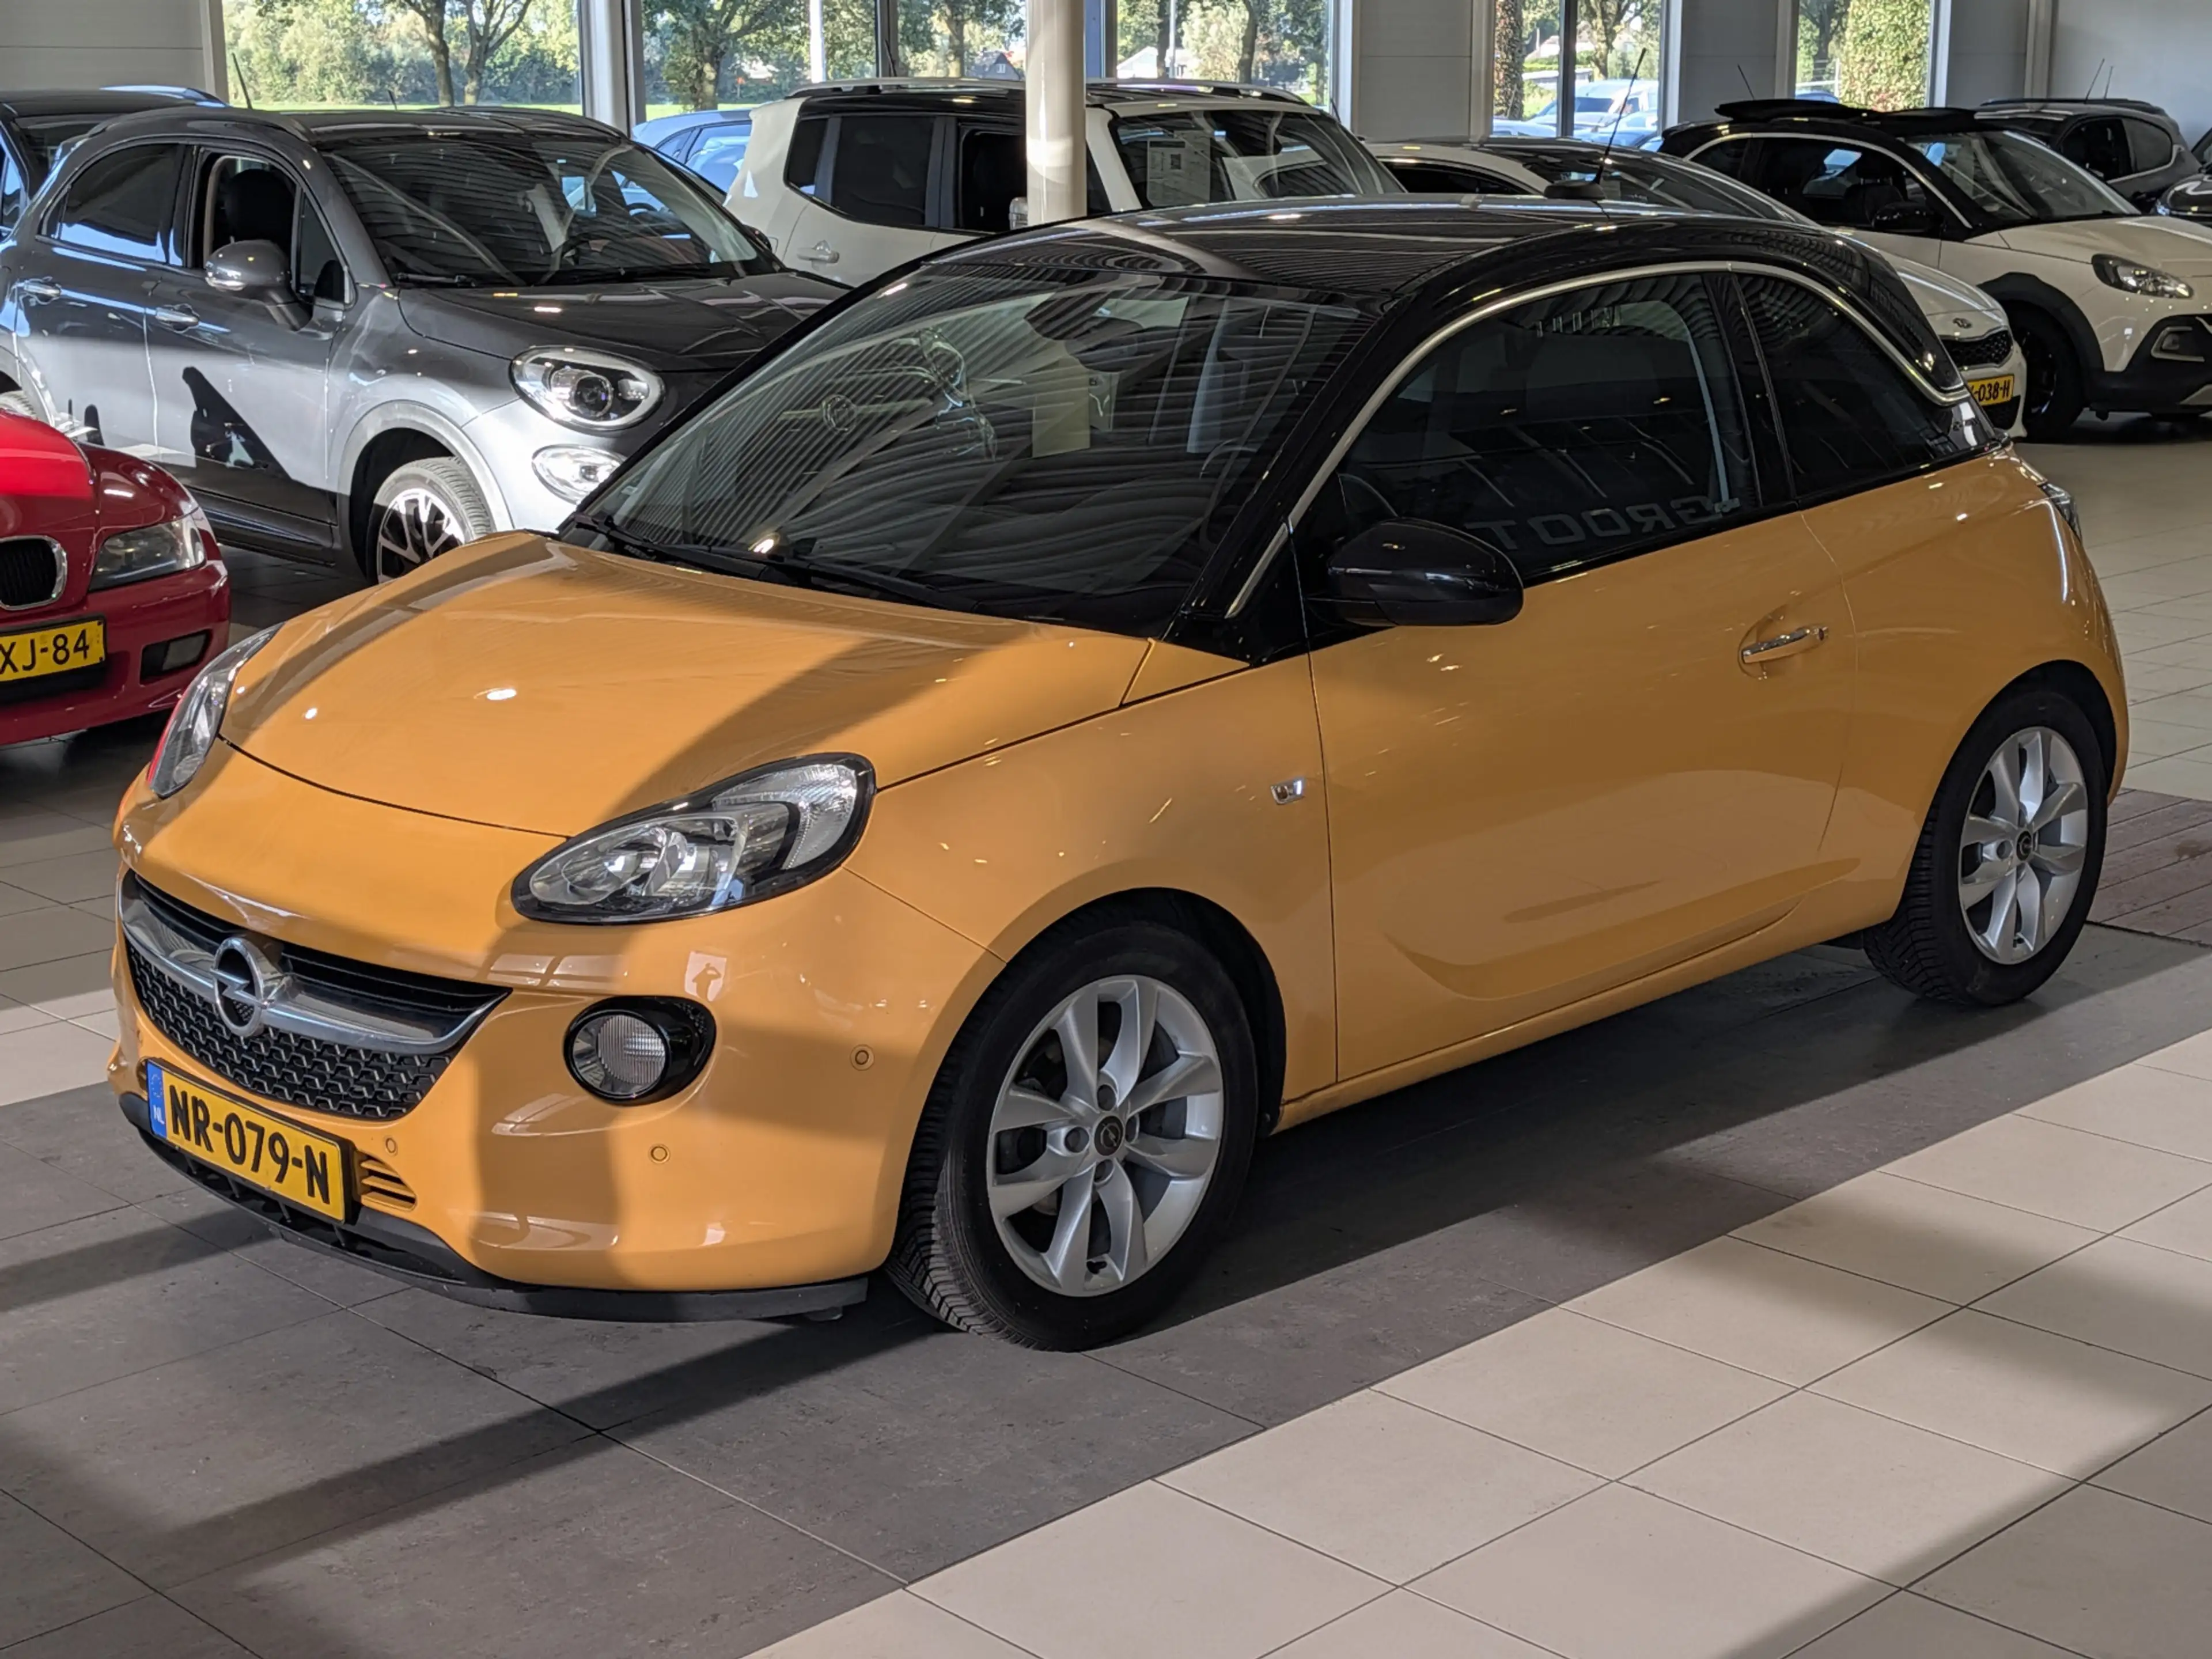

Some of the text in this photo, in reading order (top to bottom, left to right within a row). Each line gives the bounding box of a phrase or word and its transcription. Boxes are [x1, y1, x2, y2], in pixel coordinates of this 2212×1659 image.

[1971, 380, 2011, 402] -038-H
[0, 629, 89, 675] XJ-84
[153, 1105, 165, 1124] NL
[169, 1085, 330, 1205] NR-079-N
